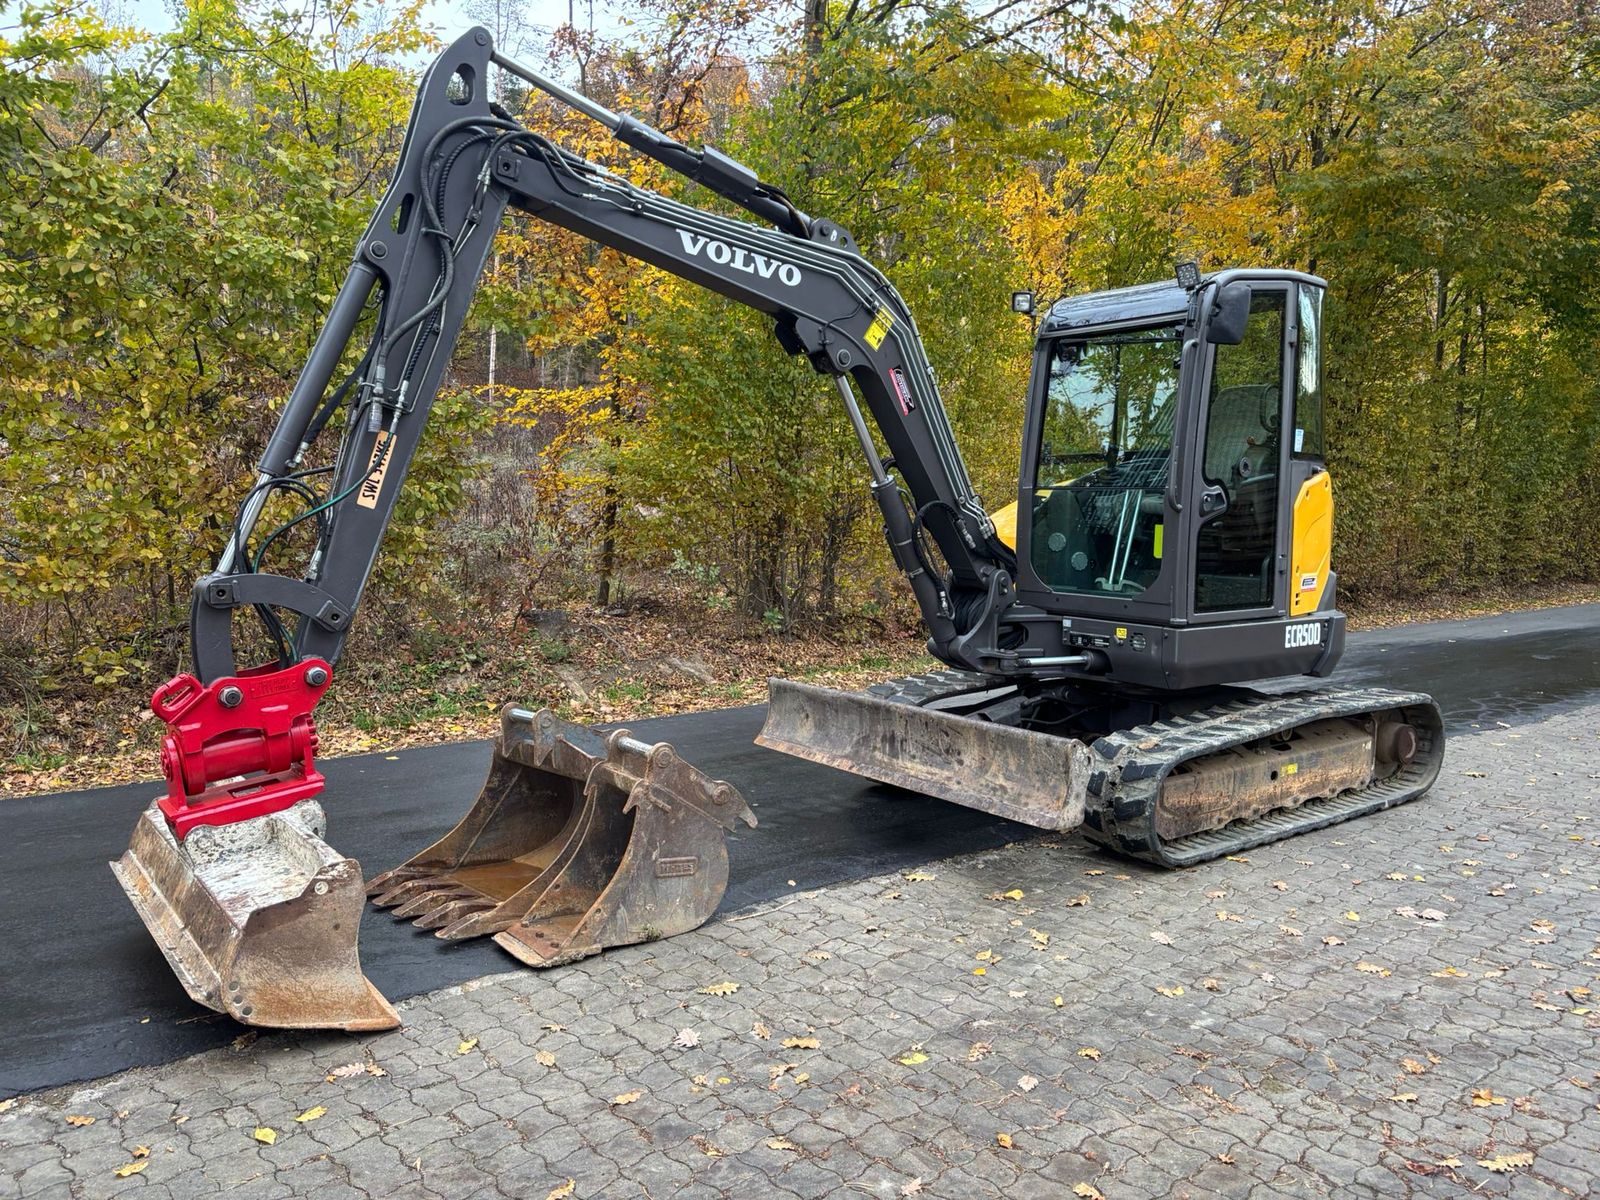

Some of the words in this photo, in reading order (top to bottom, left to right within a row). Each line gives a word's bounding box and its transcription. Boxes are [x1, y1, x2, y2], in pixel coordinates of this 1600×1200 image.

[676, 228, 802, 287] VOLVO
[362, 478, 380, 501] SWL
[1285, 622, 1321, 649] ECR50D
